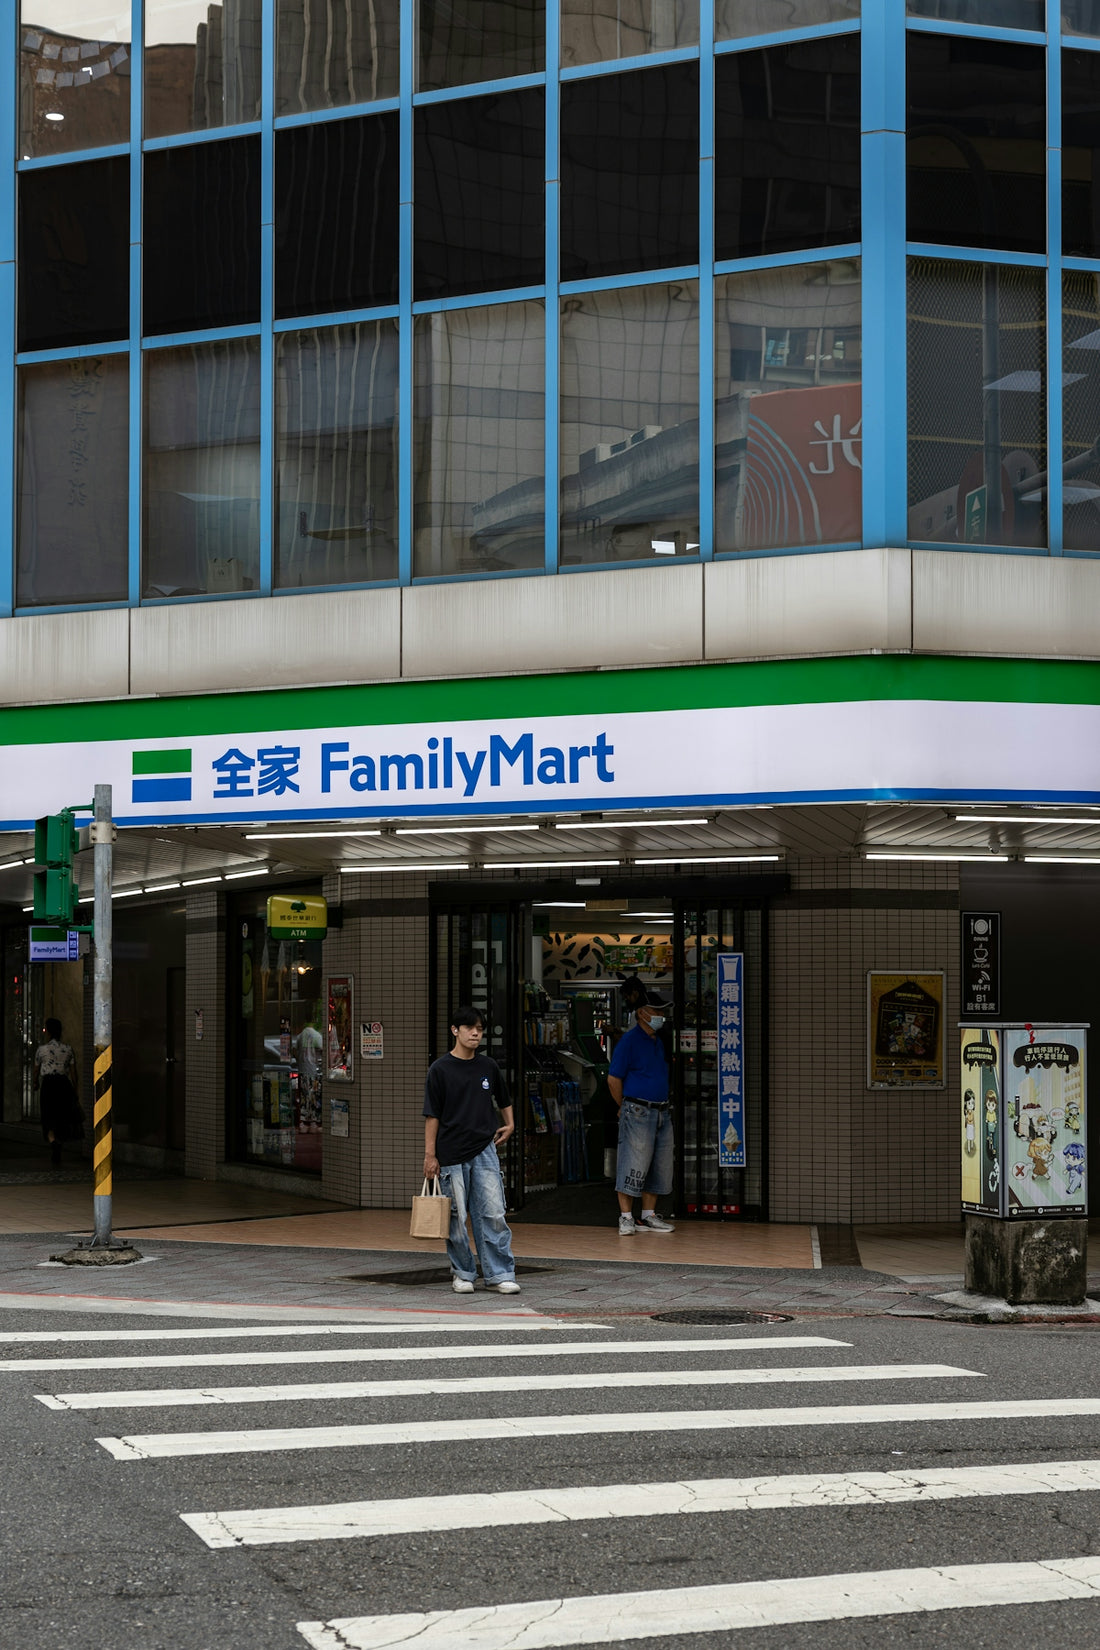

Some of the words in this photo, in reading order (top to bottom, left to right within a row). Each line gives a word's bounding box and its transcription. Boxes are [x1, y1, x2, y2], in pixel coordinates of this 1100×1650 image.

[212, 745, 300, 799] 全家
[320, 731, 615, 797] FamilyMart
[33, 946, 66, 954] FamilyMart
[290, 929, 307, 937] ATM
[720, 983, 741, 1119] 霜淇淋熱賣中
